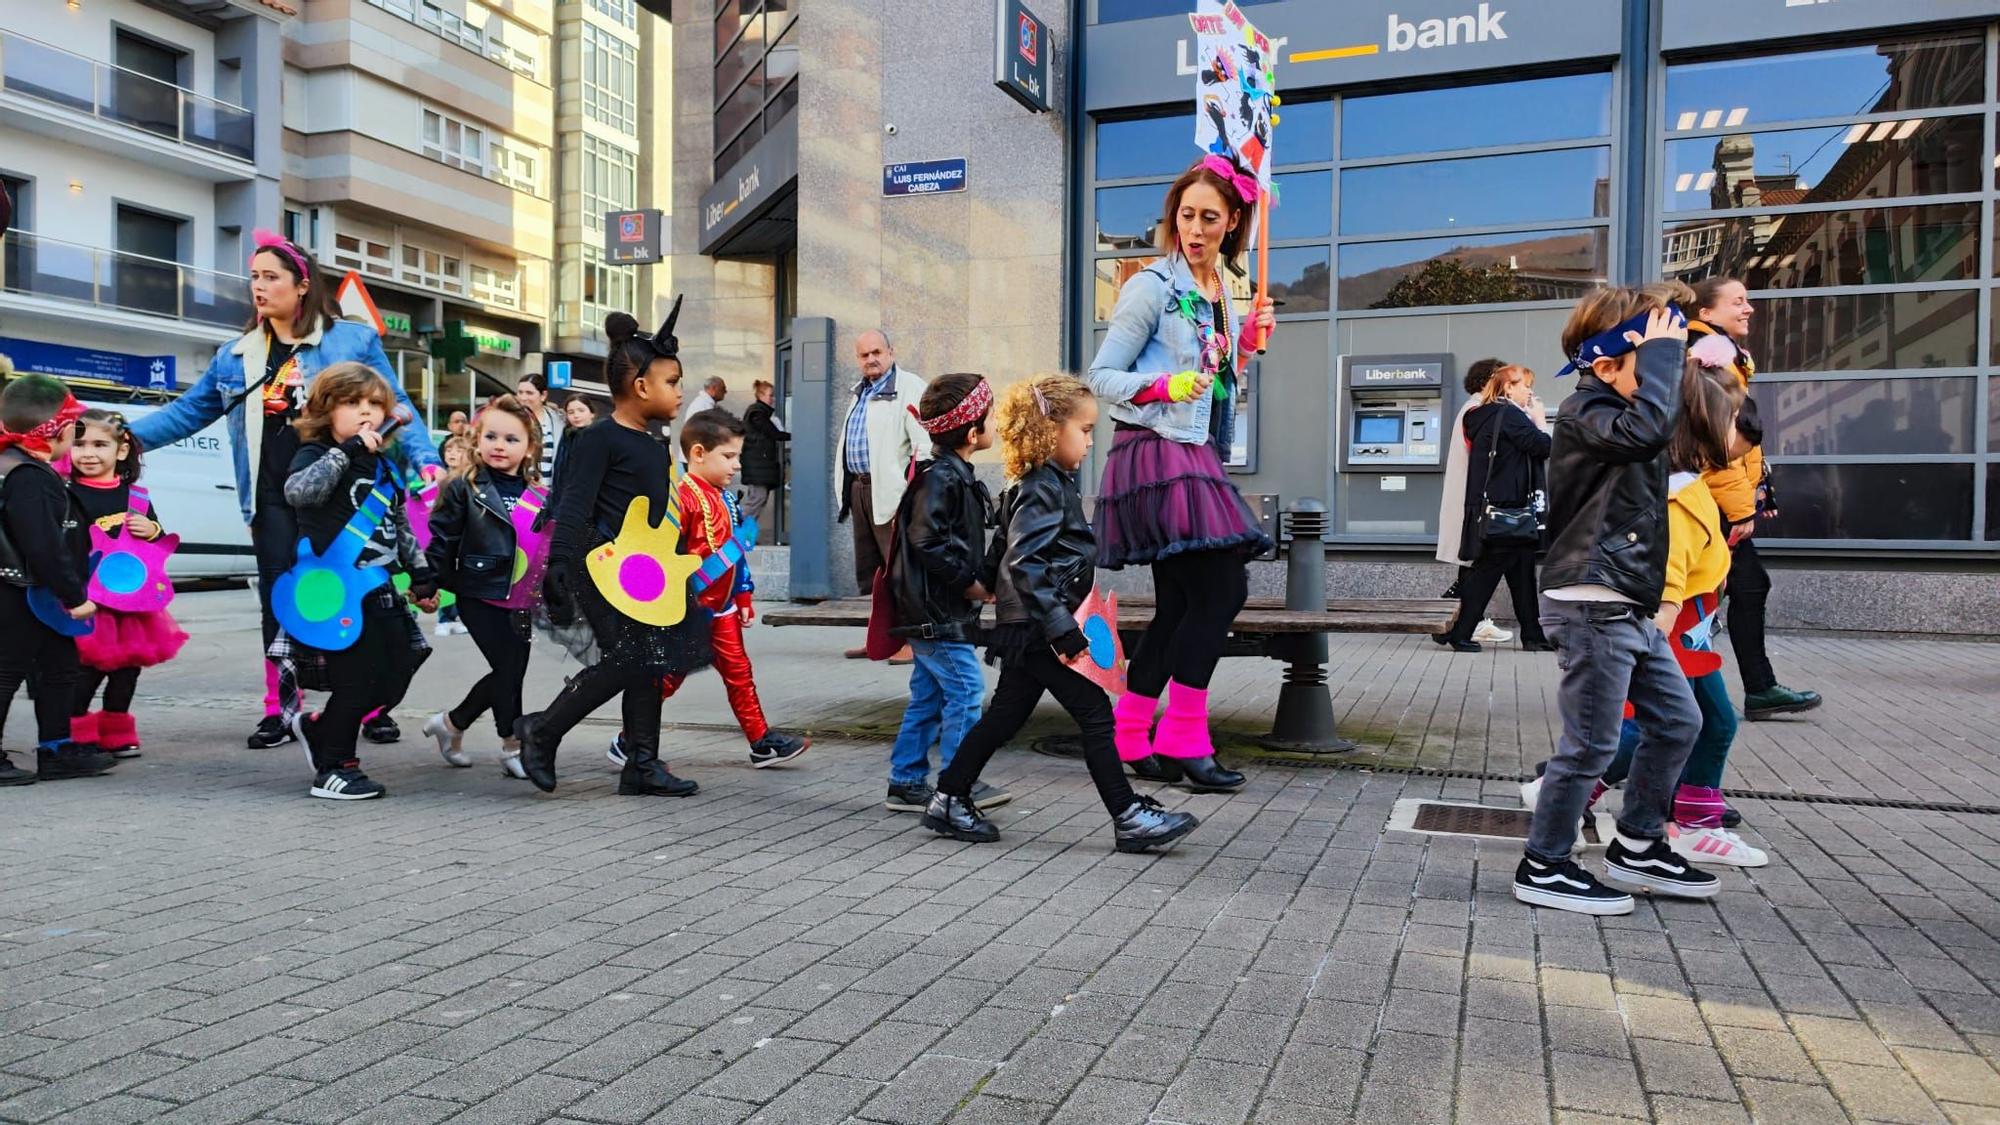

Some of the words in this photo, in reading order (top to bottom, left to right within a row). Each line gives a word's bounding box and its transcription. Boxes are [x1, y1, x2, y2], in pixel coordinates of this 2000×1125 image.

[1387, 3, 1508, 52] bank
[894, 175, 912, 184] LUIS
[913, 169, 963, 182] FERNÁNDEZ
[908, 182, 940, 193] CABEZA
[1365, 368, 1426, 380] Liberbank
